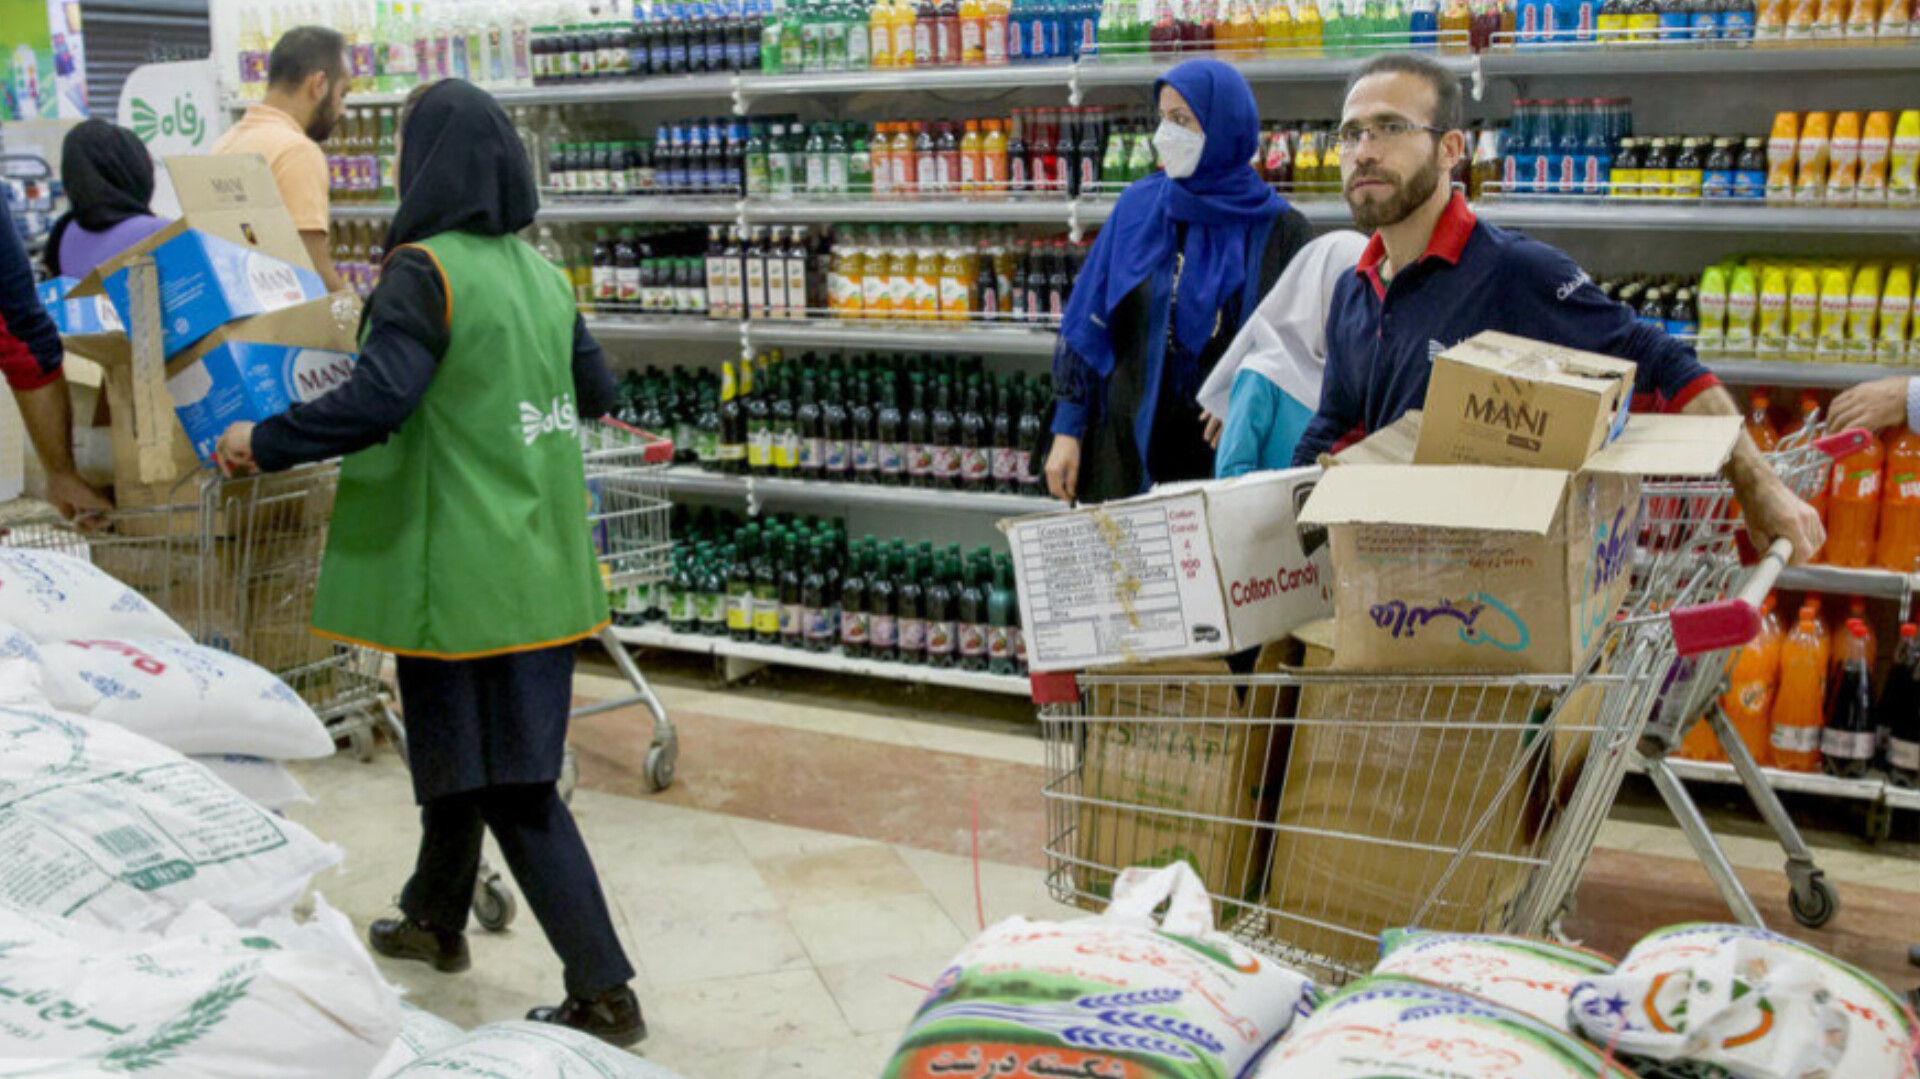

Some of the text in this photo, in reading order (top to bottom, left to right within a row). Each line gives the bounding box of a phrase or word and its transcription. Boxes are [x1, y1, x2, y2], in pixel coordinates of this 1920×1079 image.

[162, 91, 205, 147] رفاه
[1463, 392, 1549, 437] MANI
[1230, 560, 1319, 607] Cotton Candy
